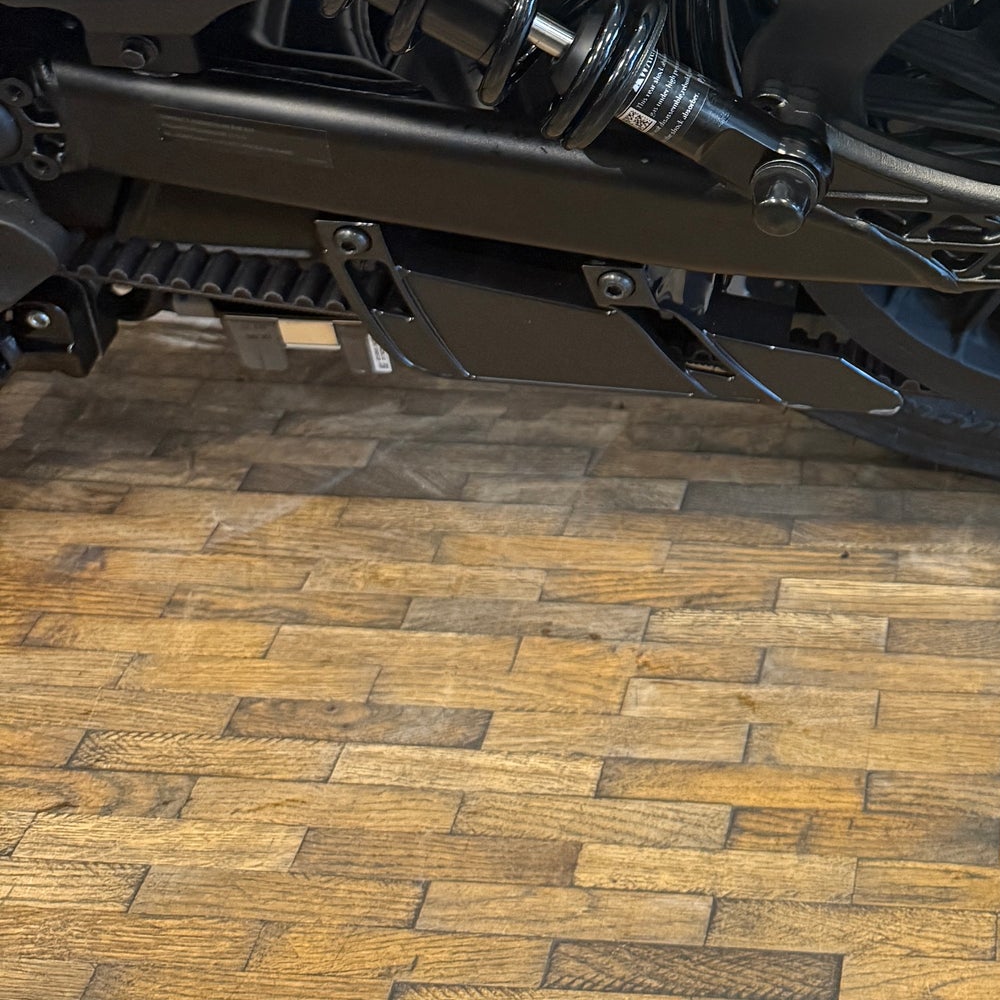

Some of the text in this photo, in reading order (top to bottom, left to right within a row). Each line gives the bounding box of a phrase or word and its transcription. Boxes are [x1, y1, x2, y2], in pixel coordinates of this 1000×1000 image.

[653, 67, 664, 85] shock
[656, 88, 670, 107] under
[671, 120, 684, 135] shock
[682, 92, 701, 120] absorber.
